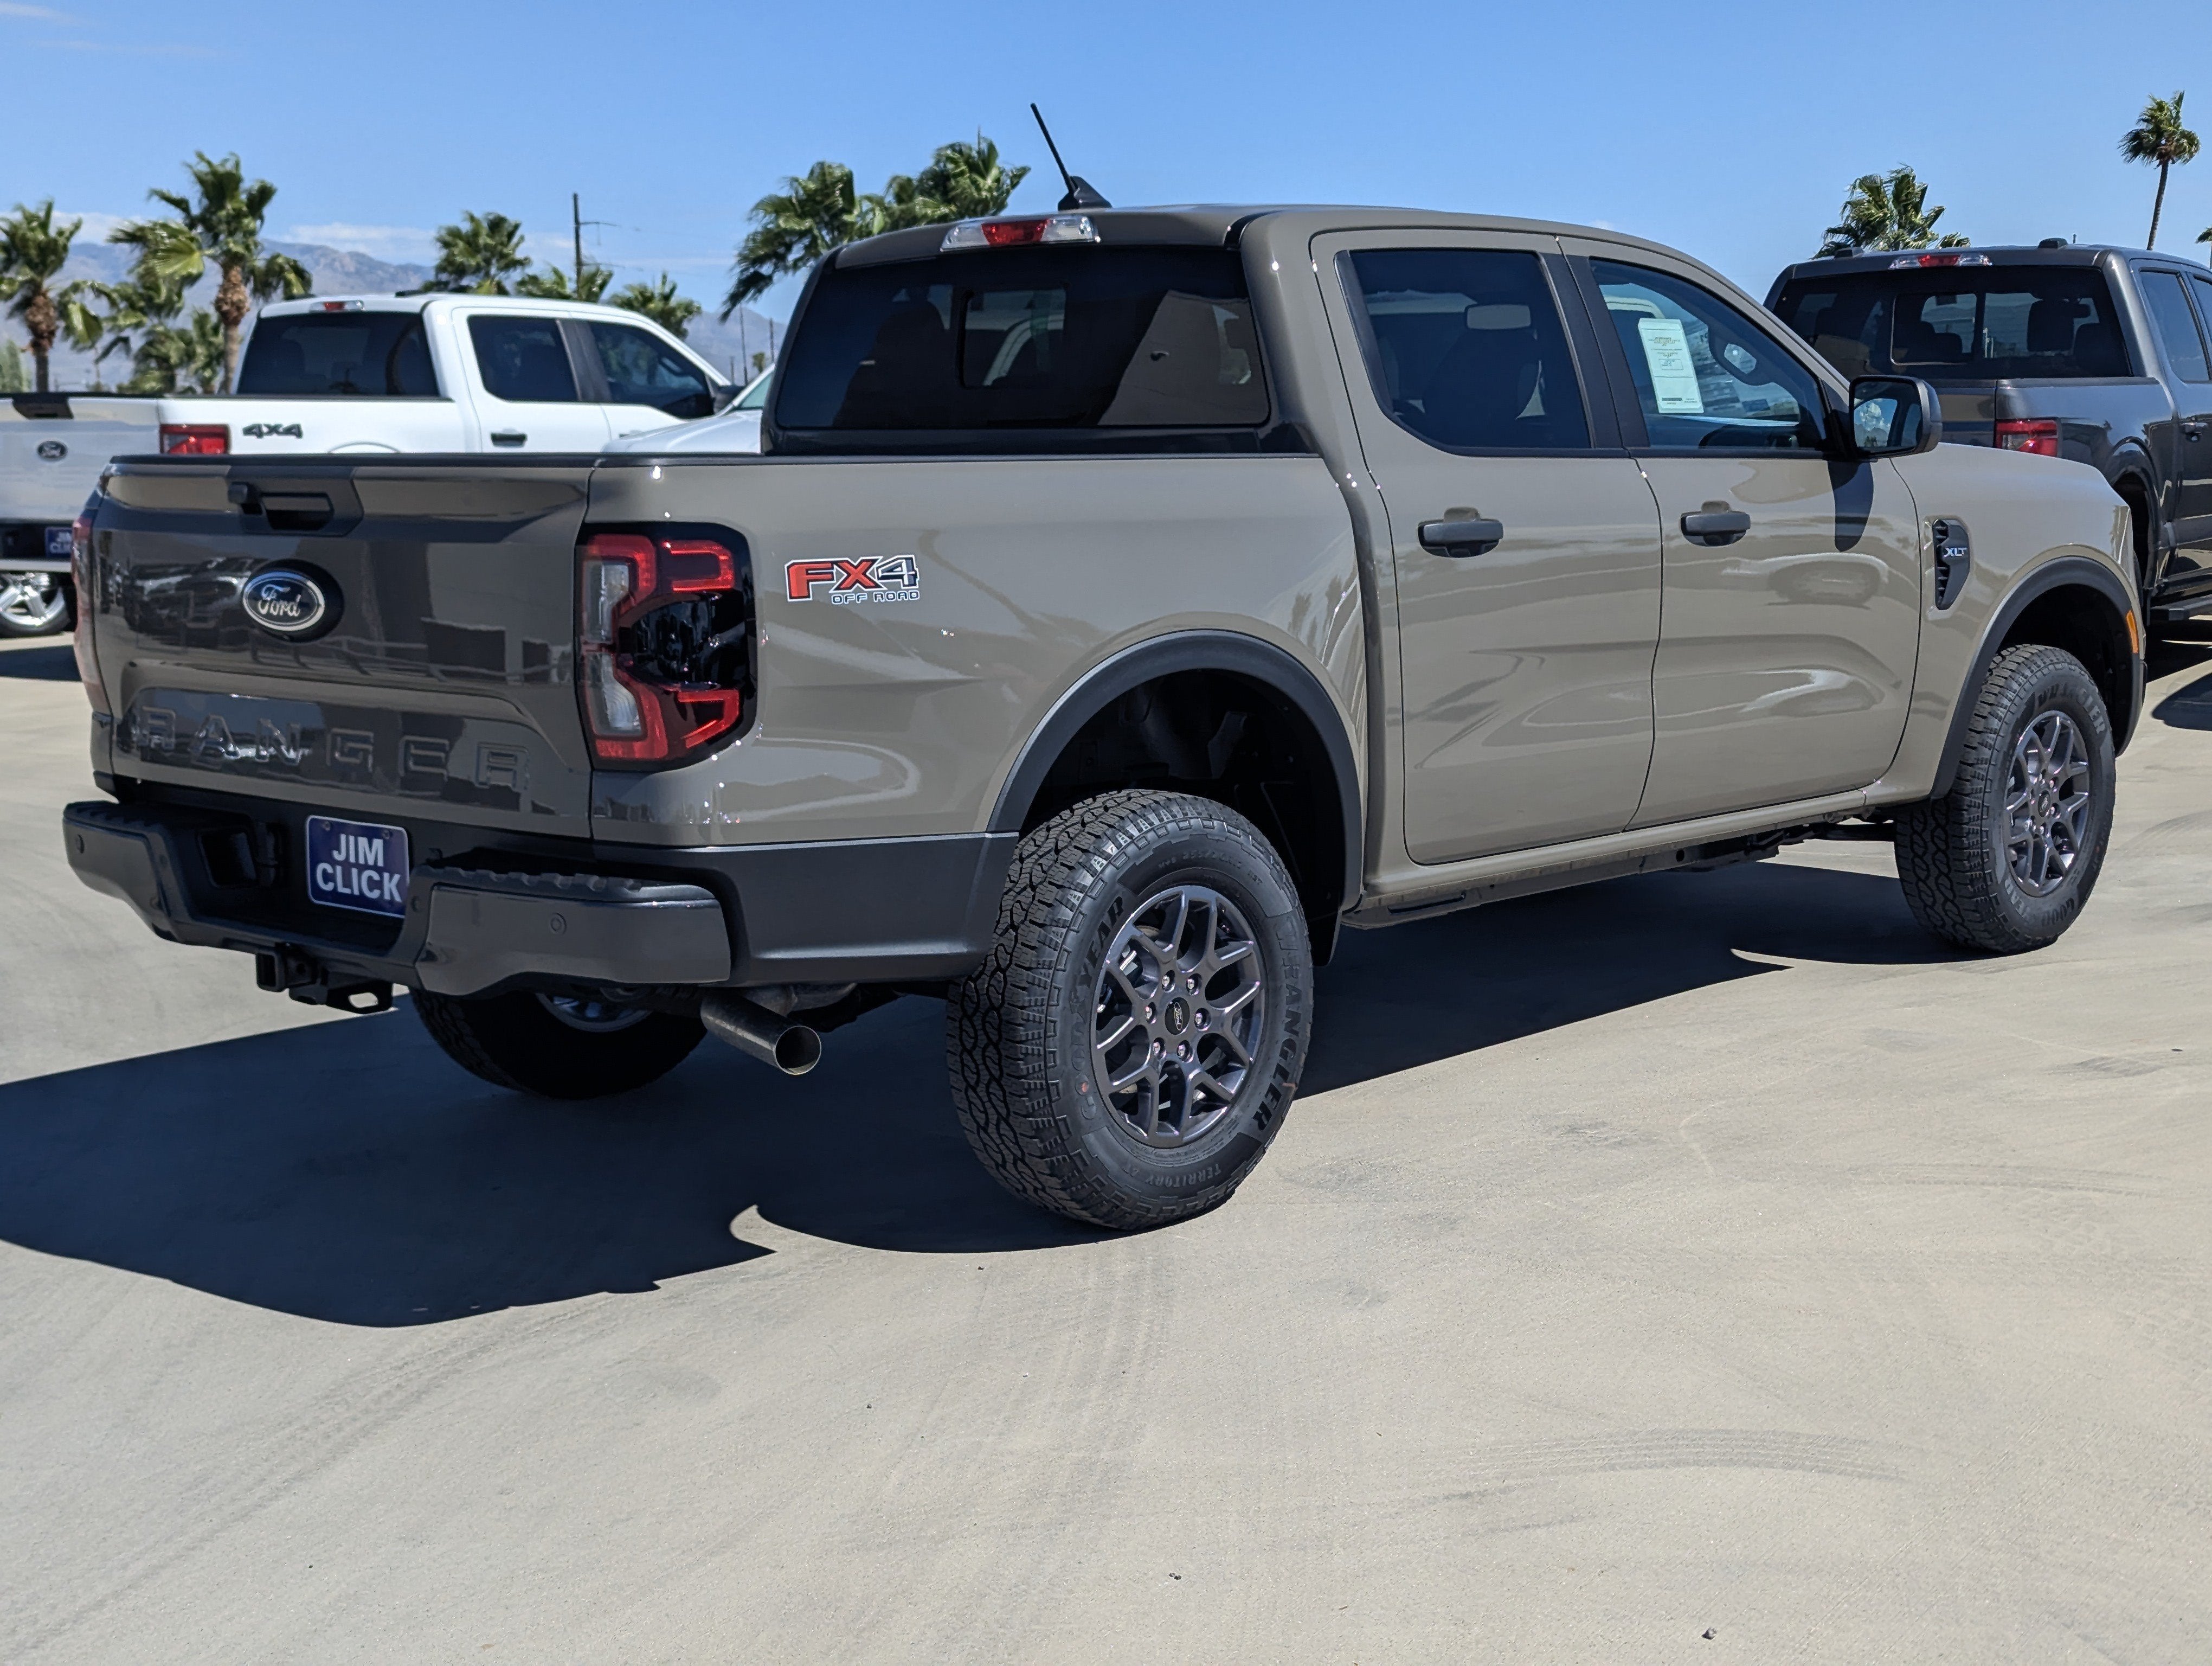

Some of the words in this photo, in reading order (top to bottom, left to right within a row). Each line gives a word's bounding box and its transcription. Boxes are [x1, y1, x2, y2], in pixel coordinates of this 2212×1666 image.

[1943, 547, 1968, 558] XLT
[785, 554, 920, 602] FX4
[258, 584, 301, 617] Ford
[831, 593, 867, 605] OFF
[873, 590, 921, 603] ROAD
[138, 706, 531, 794] RANGER
[332, 833, 384, 867] JIM
[316, 862, 402, 902] CLICK
[1145, 1163, 1221, 1188] TERRITORY
